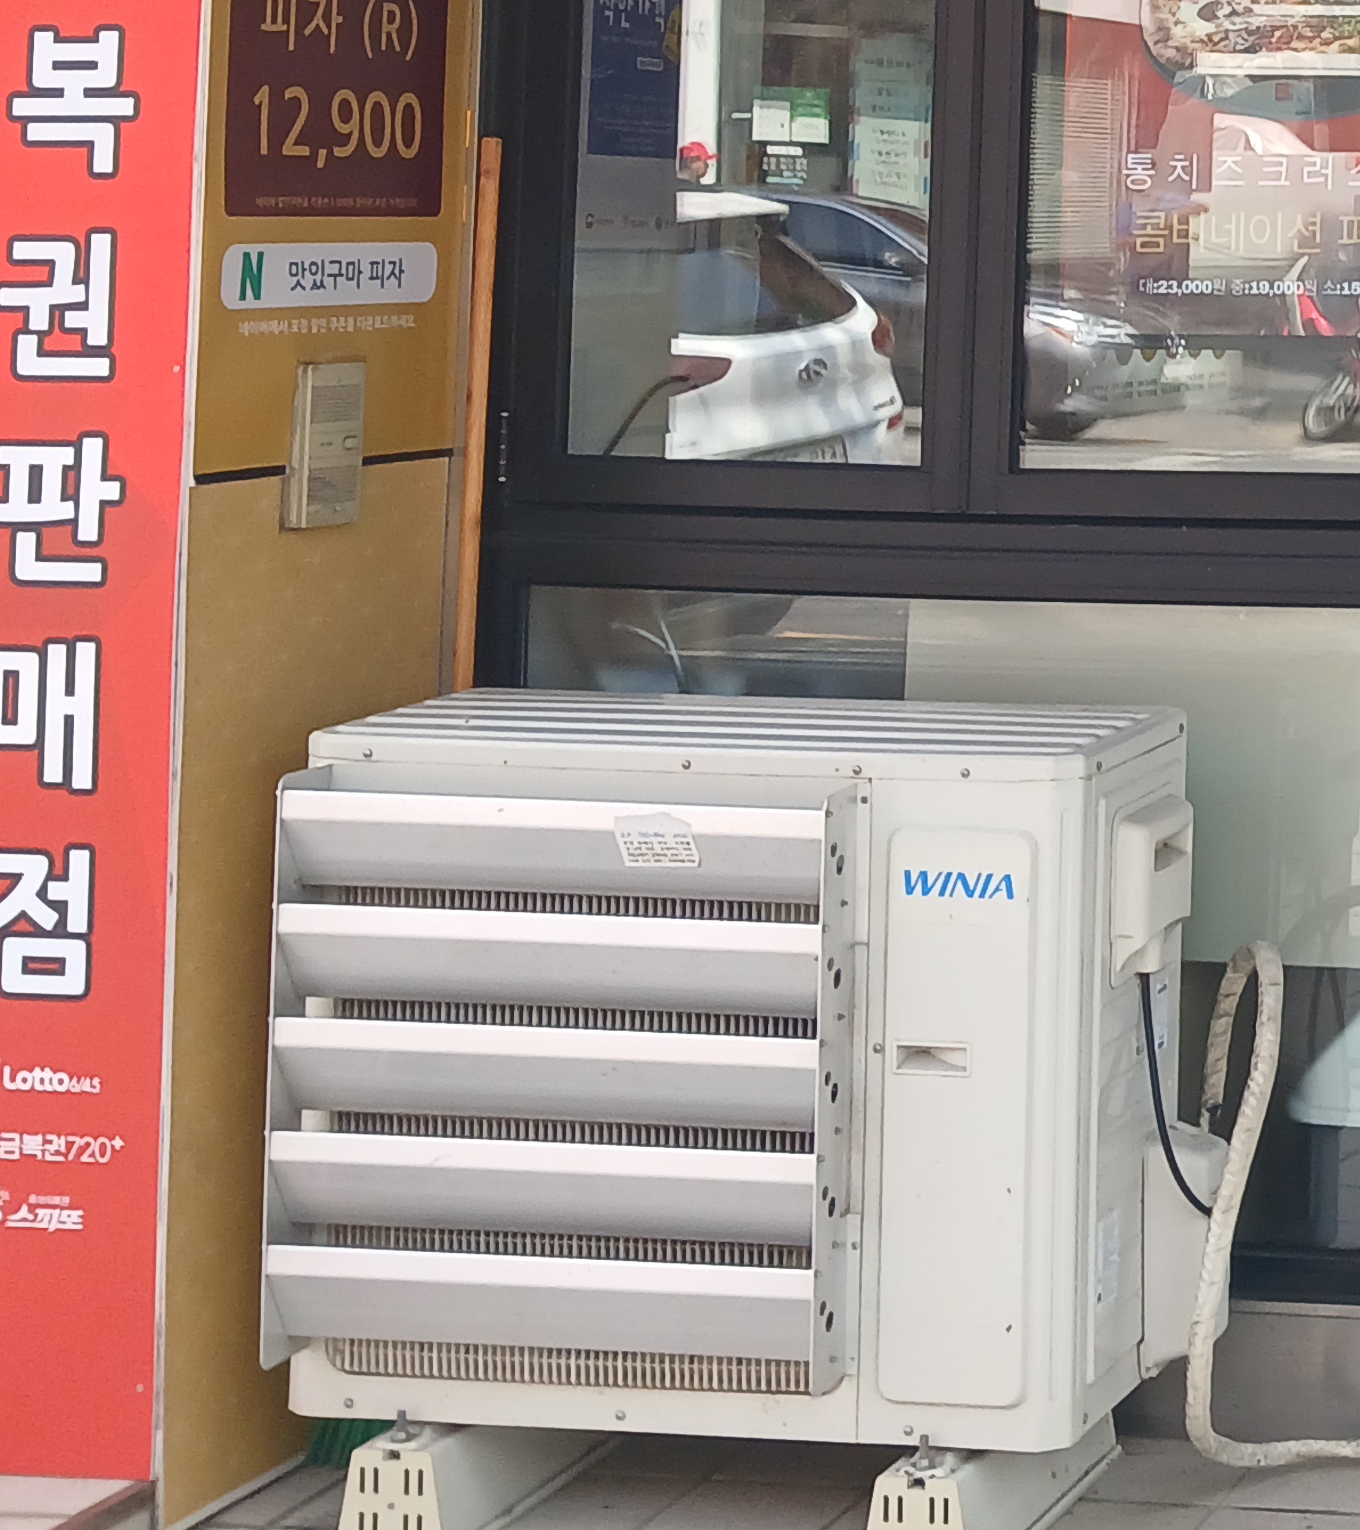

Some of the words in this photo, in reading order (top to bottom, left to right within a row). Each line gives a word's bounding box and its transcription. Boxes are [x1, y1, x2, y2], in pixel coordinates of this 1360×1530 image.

[253, 83, 423, 169] 12,900
[1131, 210, 1323, 255] 콤비네이션
[287, 258, 364, 292] 맛있구마
[367, 257, 406, 290] 피자
[0, 26, 138, 1002] 복권판매점
[902, 868, 1016, 901] WINIA
